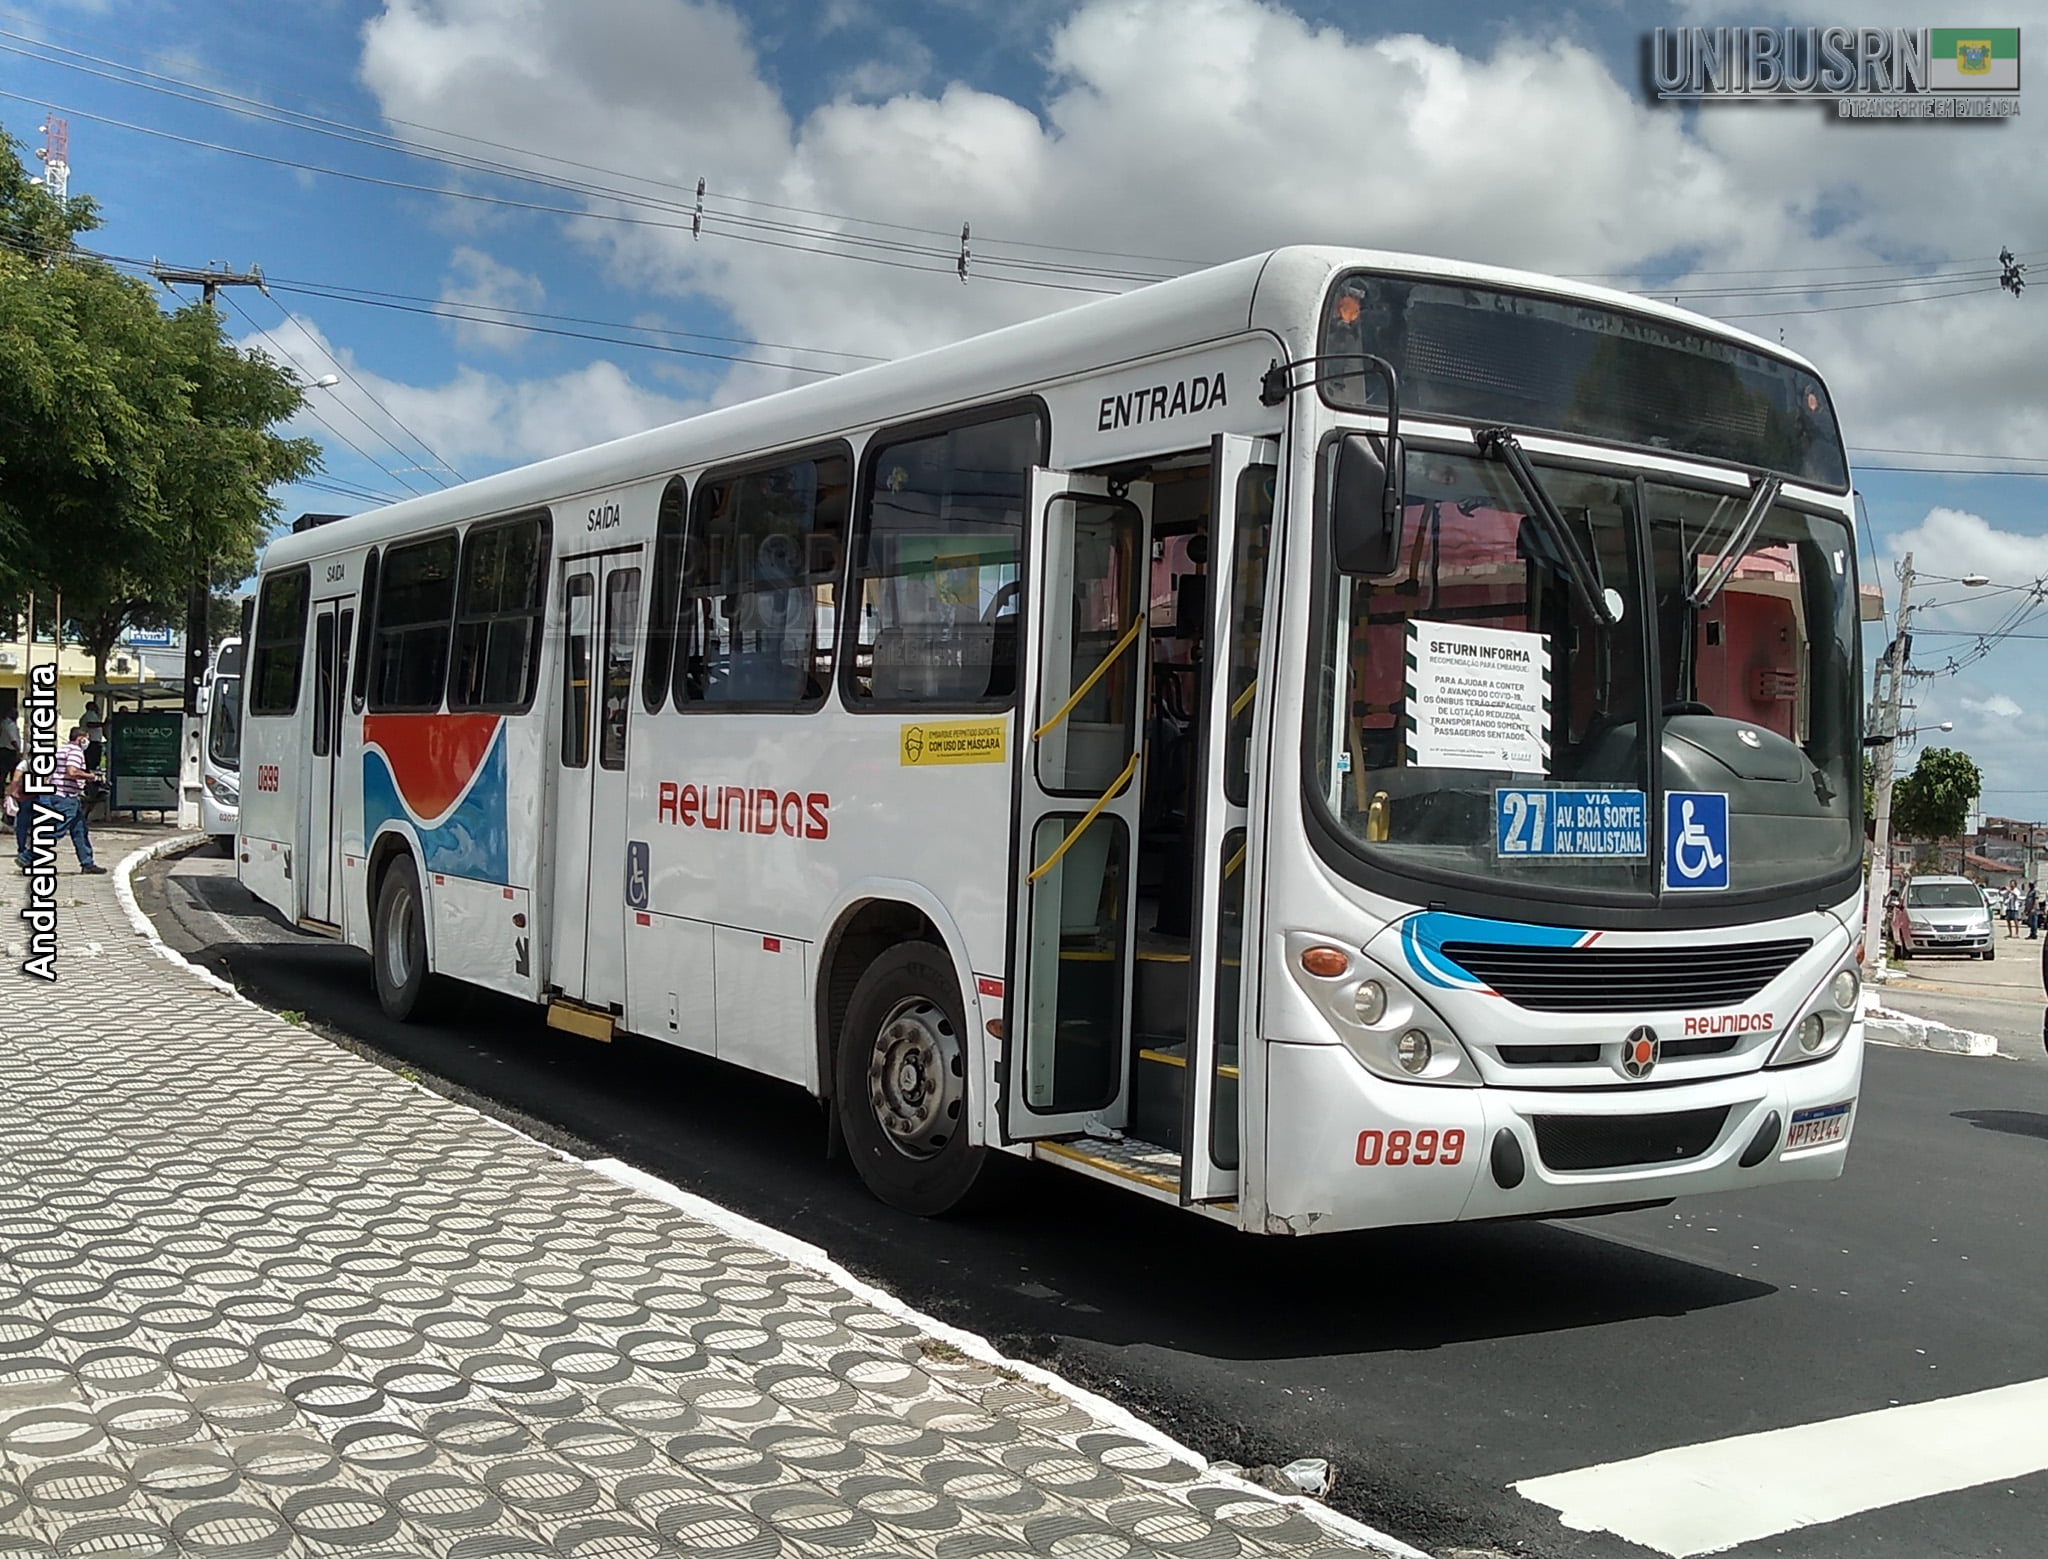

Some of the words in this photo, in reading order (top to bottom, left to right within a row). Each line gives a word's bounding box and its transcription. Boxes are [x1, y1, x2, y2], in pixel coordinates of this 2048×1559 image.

[1098, 371, 1228, 432] ENTRADA
[587, 499, 620, 532] SAÍDA
[326, 560, 345, 583] SAÍDA
[1429, 656, 1479, 668] RECOMENDAÇÃO
[1430, 641, 1477, 657] SETURN
[1480, 646, 1531, 663] INFORMA
[1434, 675, 1456, 685] PARA
[1457, 678, 1487, 688] AJUDAR
[1495, 682, 1525, 691] CONTER
[1447, 687, 1477, 698] AVANÇO
[1478, 690, 1488, 698] DO
[1423, 696, 1434, 704] OS
[1435, 695, 1464, 706] ÔNIBUS
[1466, 698, 1490, 707] TERÃO
[1491, 702, 1536, 713] CAPACIDADE
[1438, 707, 1448, 715] DE
[1450, 707, 1484, 718] LOTAÇÃO
[1430, 717, 1496, 728] TRANSPORTANDO
[1497, 721, 1530, 731] SOMENTE
[1434, 727, 1486, 738] PASSAGEIROS
[929, 741, 942, 752] COM
[944, 740, 957, 751] USO
[957, 740, 966, 750] DE
[967, 736, 1000, 750] MÁSCARA
[258, 765, 279, 792] 0899
[1585, 794, 1611, 805] VIA
[1503, 793, 1547, 853] 27
[1557, 806, 1574, 828] AV.
[1577, 806, 1601, 828] BOA
[1603, 806, 1641, 828] SORTE
[1557, 831, 1574, 853] AV.
[1576, 831, 1642, 853] PAULISTANA
[1355, 1128, 1466, 1167] 0899
